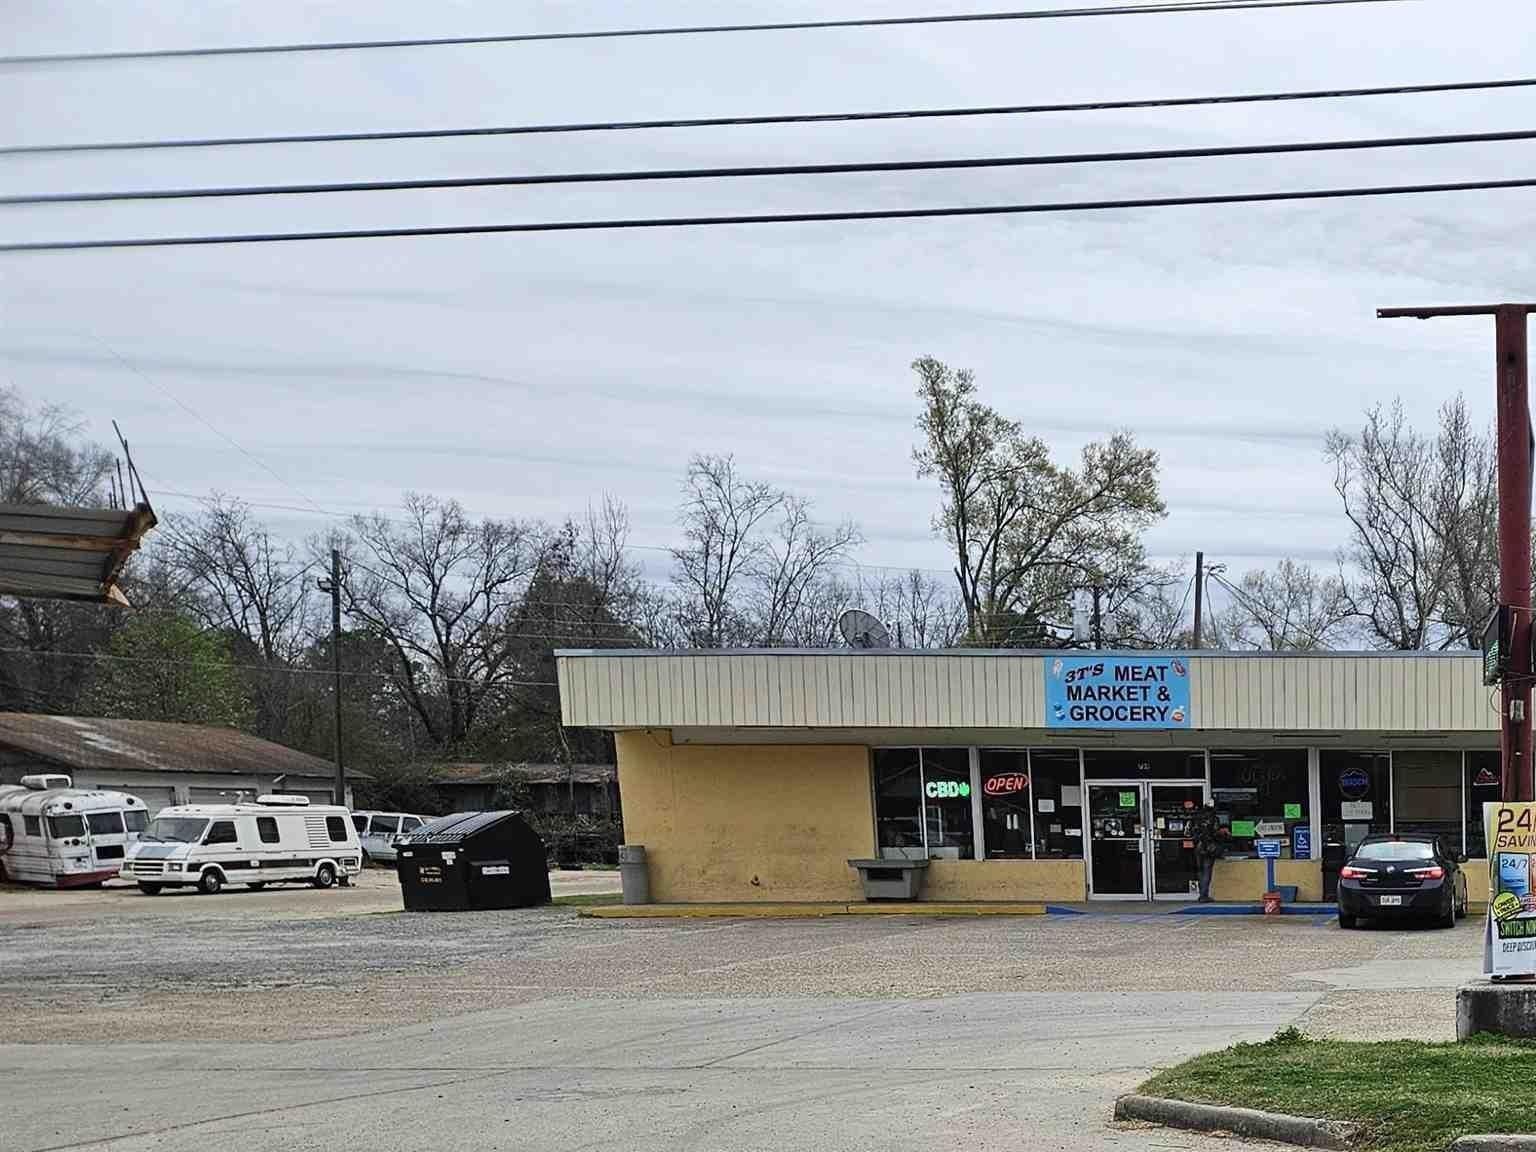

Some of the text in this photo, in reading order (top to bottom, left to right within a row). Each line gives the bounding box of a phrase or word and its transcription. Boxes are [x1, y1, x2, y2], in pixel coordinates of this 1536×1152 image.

[1065, 663, 1168, 683] 3T'S MEAT
[1067, 685, 1170, 701] MARKET &
[1070, 705, 1169, 721] GROCERY
[926, 781, 960, 798] CBD
[987, 777, 1024, 791] OPEN
[1502, 858, 1528, 869] 24/7
[1501, 921, 1525, 936] SWITCH
[1503, 942, 1517, 953] DEEP
